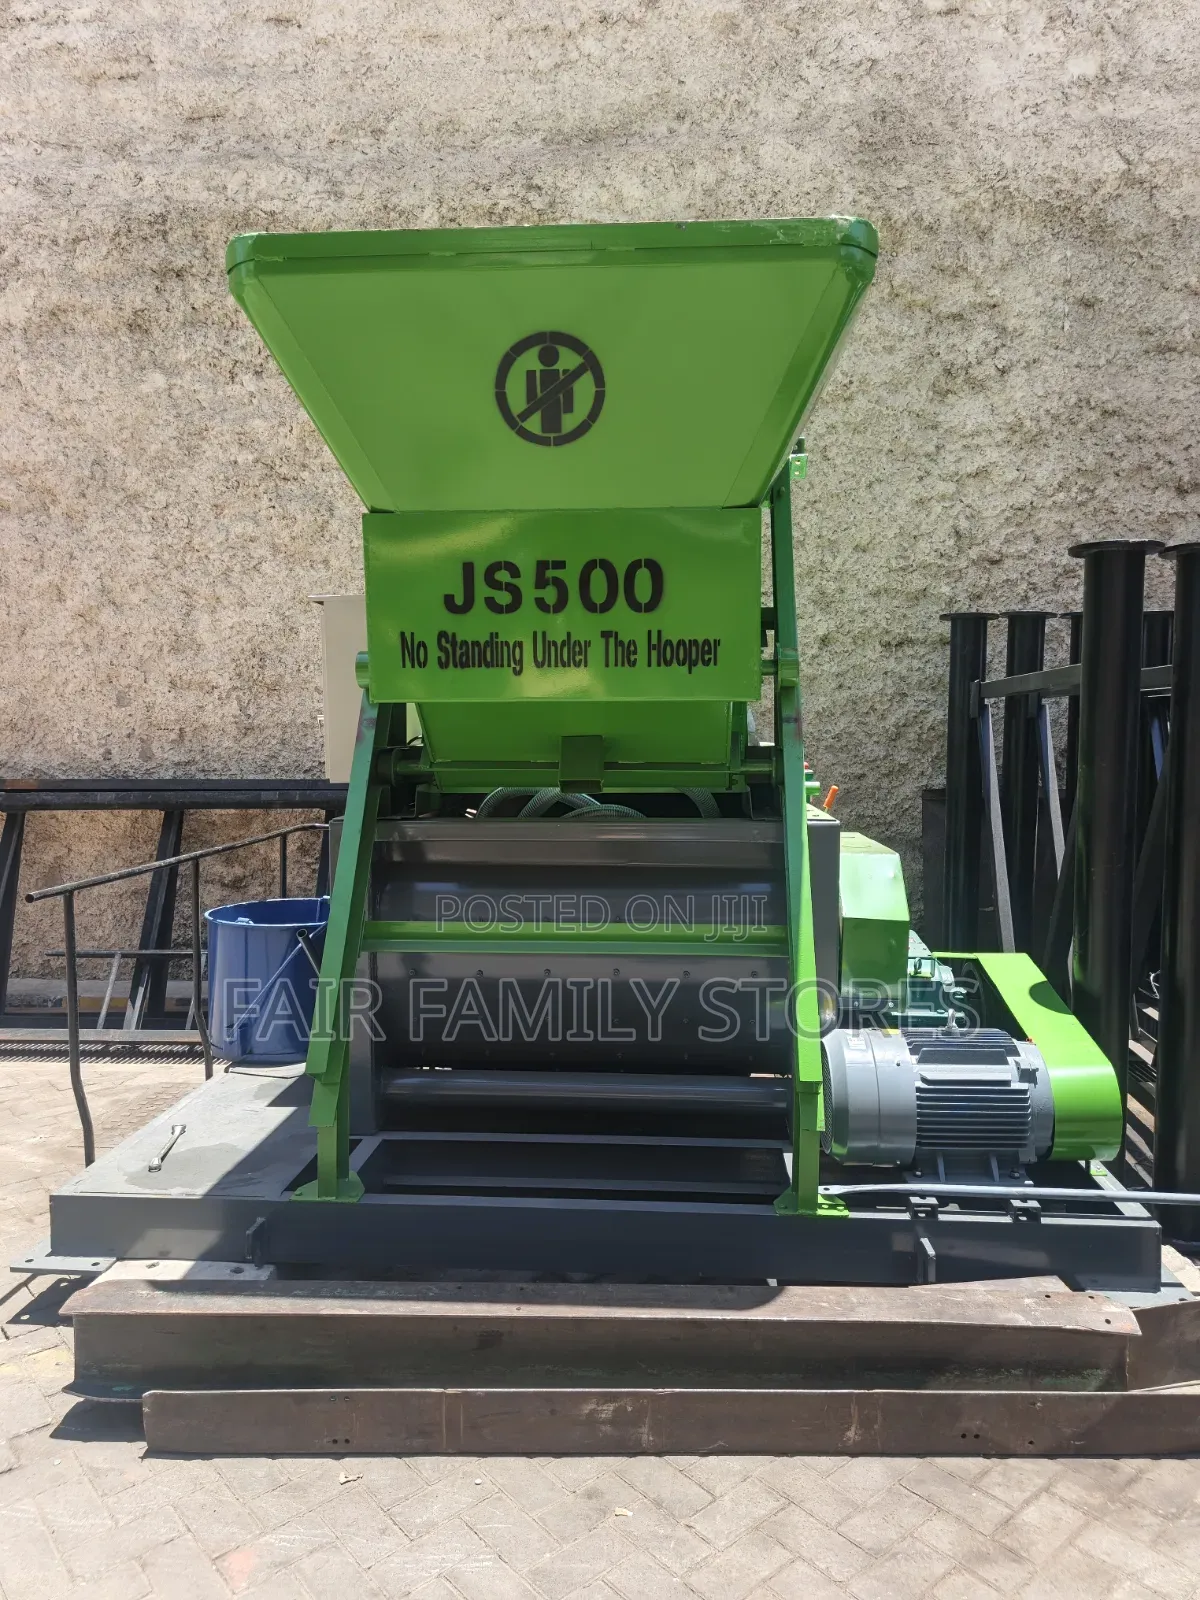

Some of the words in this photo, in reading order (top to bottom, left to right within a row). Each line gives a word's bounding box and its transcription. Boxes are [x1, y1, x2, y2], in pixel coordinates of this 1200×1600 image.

[443, 558, 663, 615] JS500
[401, 631, 428, 668] No
[437, 631, 524, 675] Standing
[533, 631, 591, 668] Under
[601, 630, 637, 668] The
[648, 629, 720, 674] Hooper
